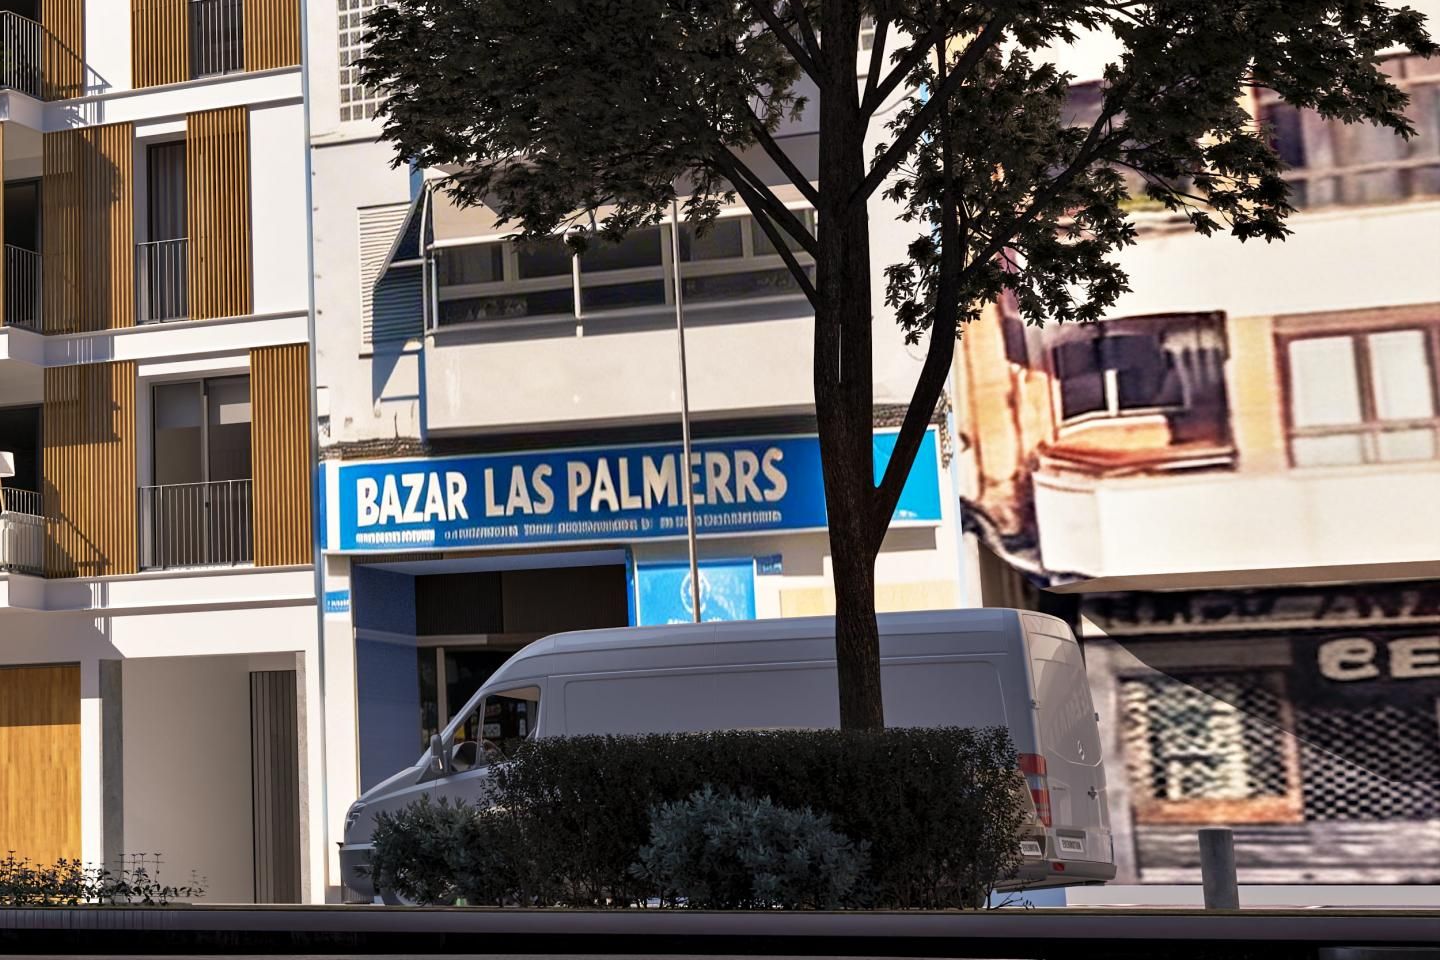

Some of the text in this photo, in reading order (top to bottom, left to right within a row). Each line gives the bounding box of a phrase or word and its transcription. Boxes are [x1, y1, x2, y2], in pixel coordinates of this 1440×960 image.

[356, 447, 788, 527] BAZAR LAS PALMERRS
